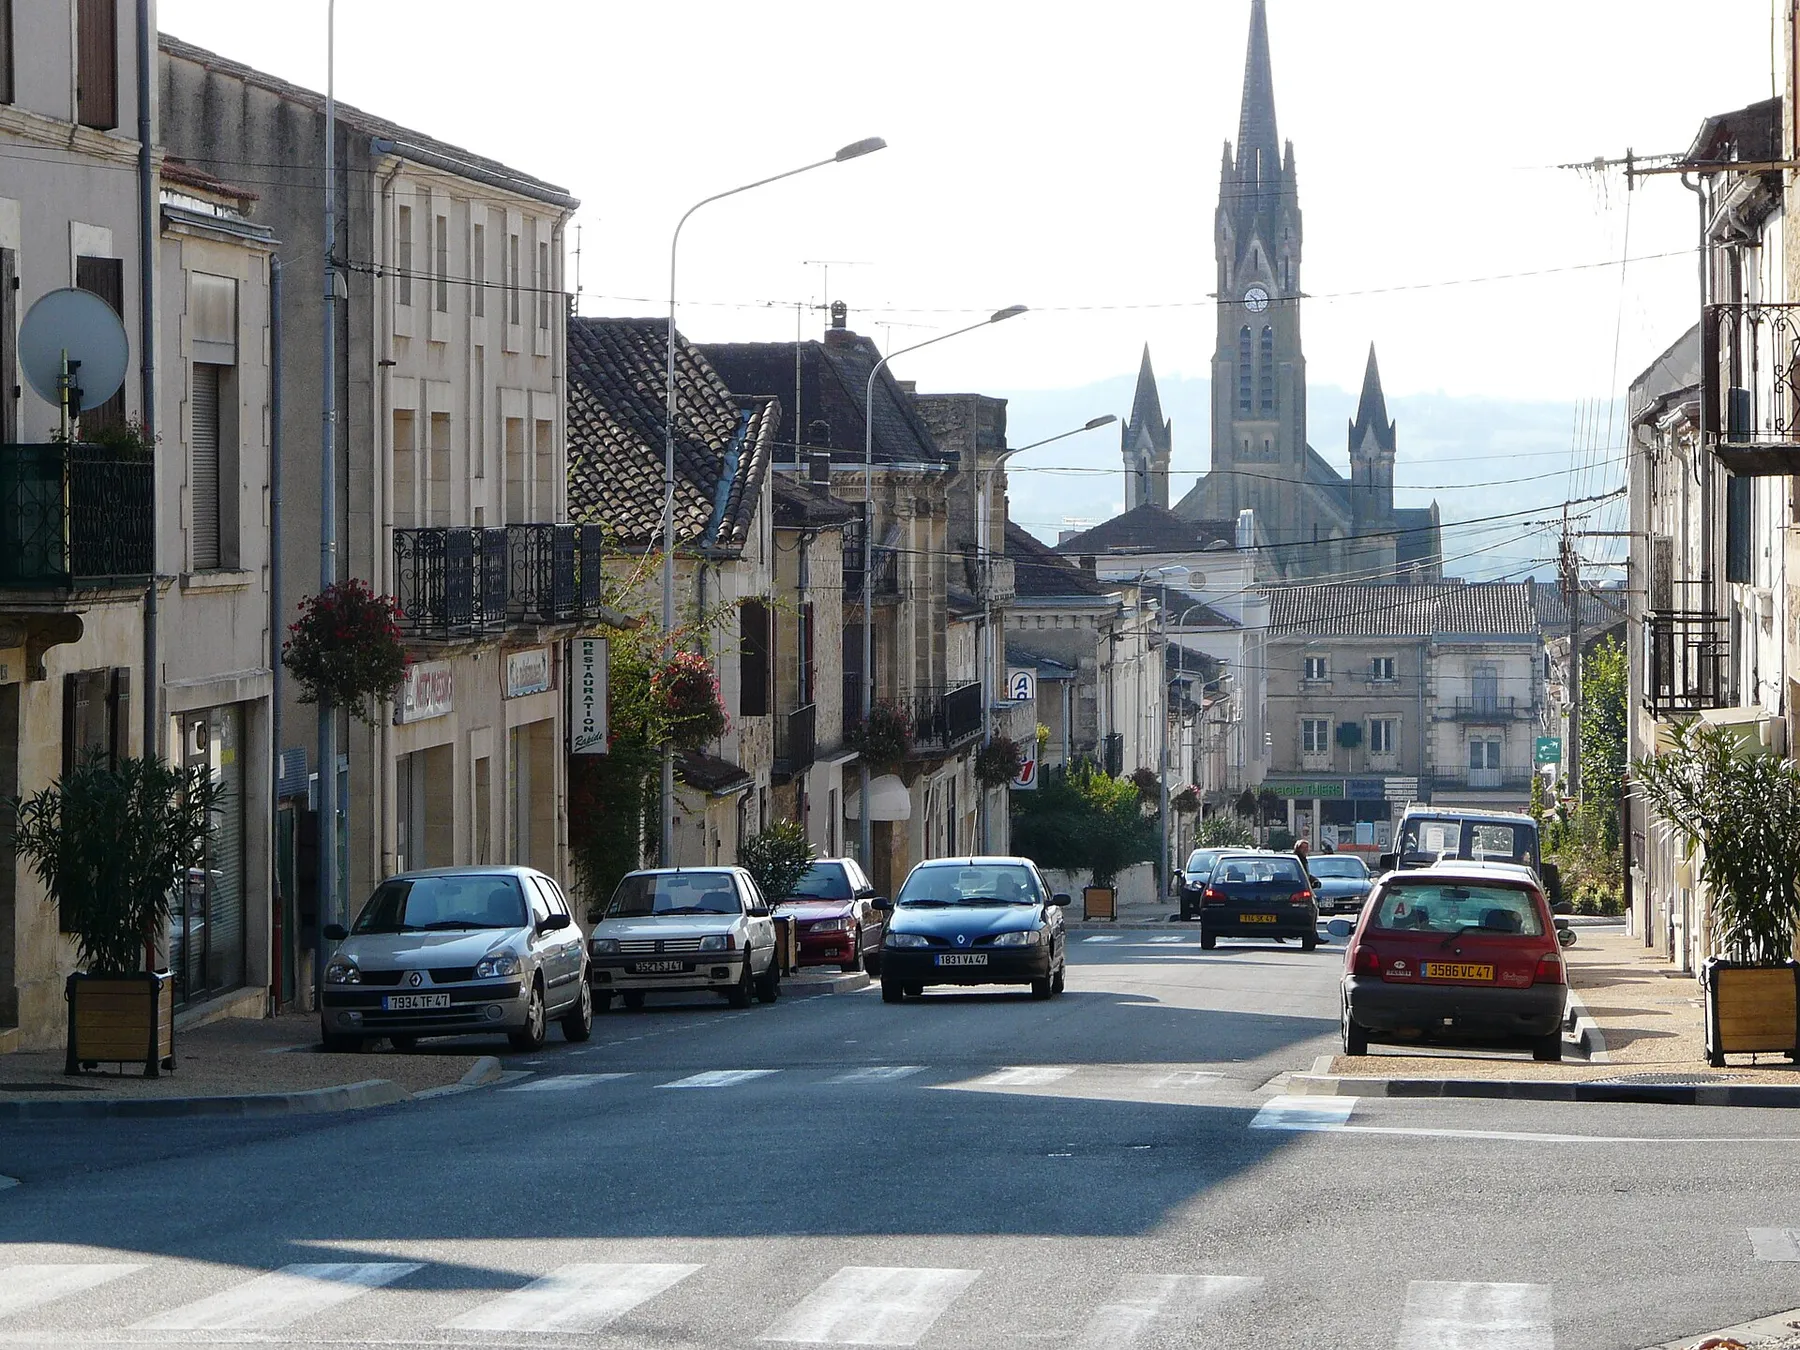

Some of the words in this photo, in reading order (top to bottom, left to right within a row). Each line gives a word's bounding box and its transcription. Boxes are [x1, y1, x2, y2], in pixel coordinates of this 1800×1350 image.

[582, 640, 595, 733] RESTAURATION
[574, 731, 604, 752] Rapide
[1250, 783, 1304, 797] armacie
[1305, 782, 1343, 797] THIERS
[1394, 902, 1406, 916] A
[941, 956, 961, 964] 1831
[963, 956, 974, 964] VA
[976, 956, 986, 964] 47
[1430, 963, 1459, 979] 3586
[1460, 963, 1476, 979] VC
[1476, 964, 1491, 979] 47
[391, 997, 418, 1009] 7934
[421, 996, 432, 1007] TF
[435, 995, 447, 1006] 47
